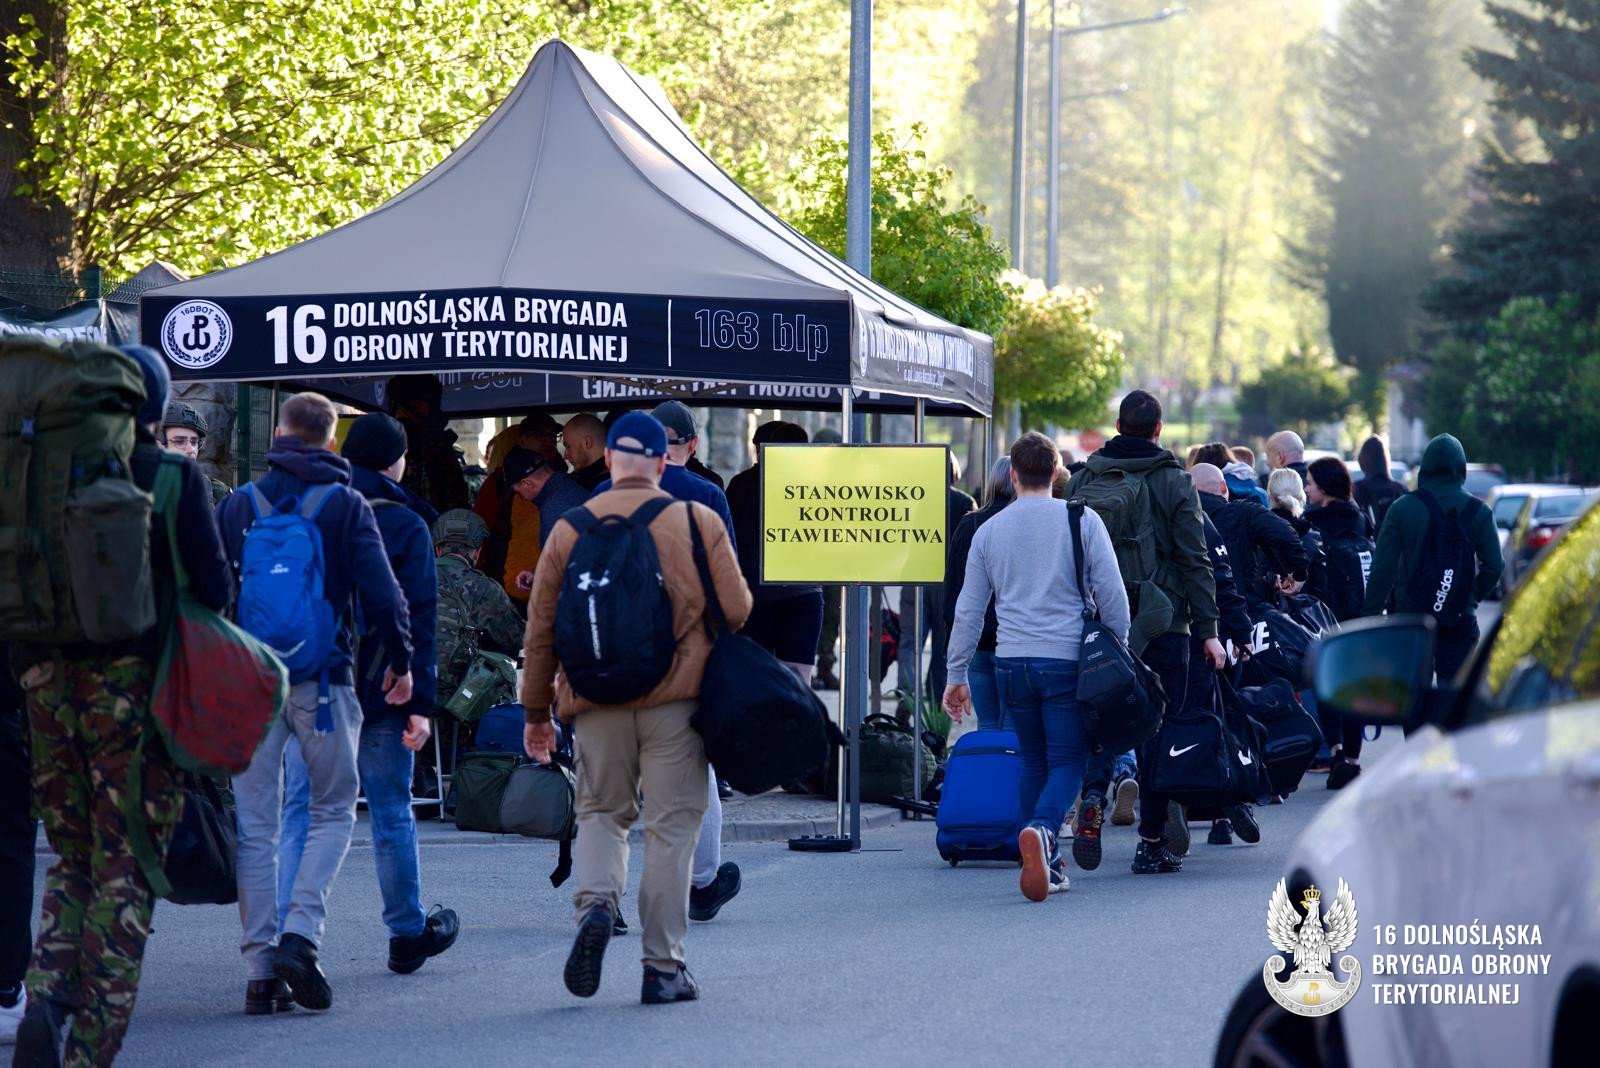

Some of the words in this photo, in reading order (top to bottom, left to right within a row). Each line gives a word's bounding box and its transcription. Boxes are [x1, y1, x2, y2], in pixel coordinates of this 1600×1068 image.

[181, 306, 214, 316] 16DBOT
[266, 304, 327, 364] 16
[333, 293, 506, 330] DOLNOŚLĄSKA
[514, 297, 627, 327] BRYGADA
[694, 309, 760, 350] 163
[772, 313, 829, 361] blp
[334, 332, 434, 363] OBRONY
[441, 330, 628, 363] TERYTORIALNEJ
[784, 485, 926, 500] STANOWISKO
[799, 507, 912, 522] KONTROLI
[765, 527, 944, 543] STAWIENNICTWA
[1433, 569, 1454, 612] adidas
